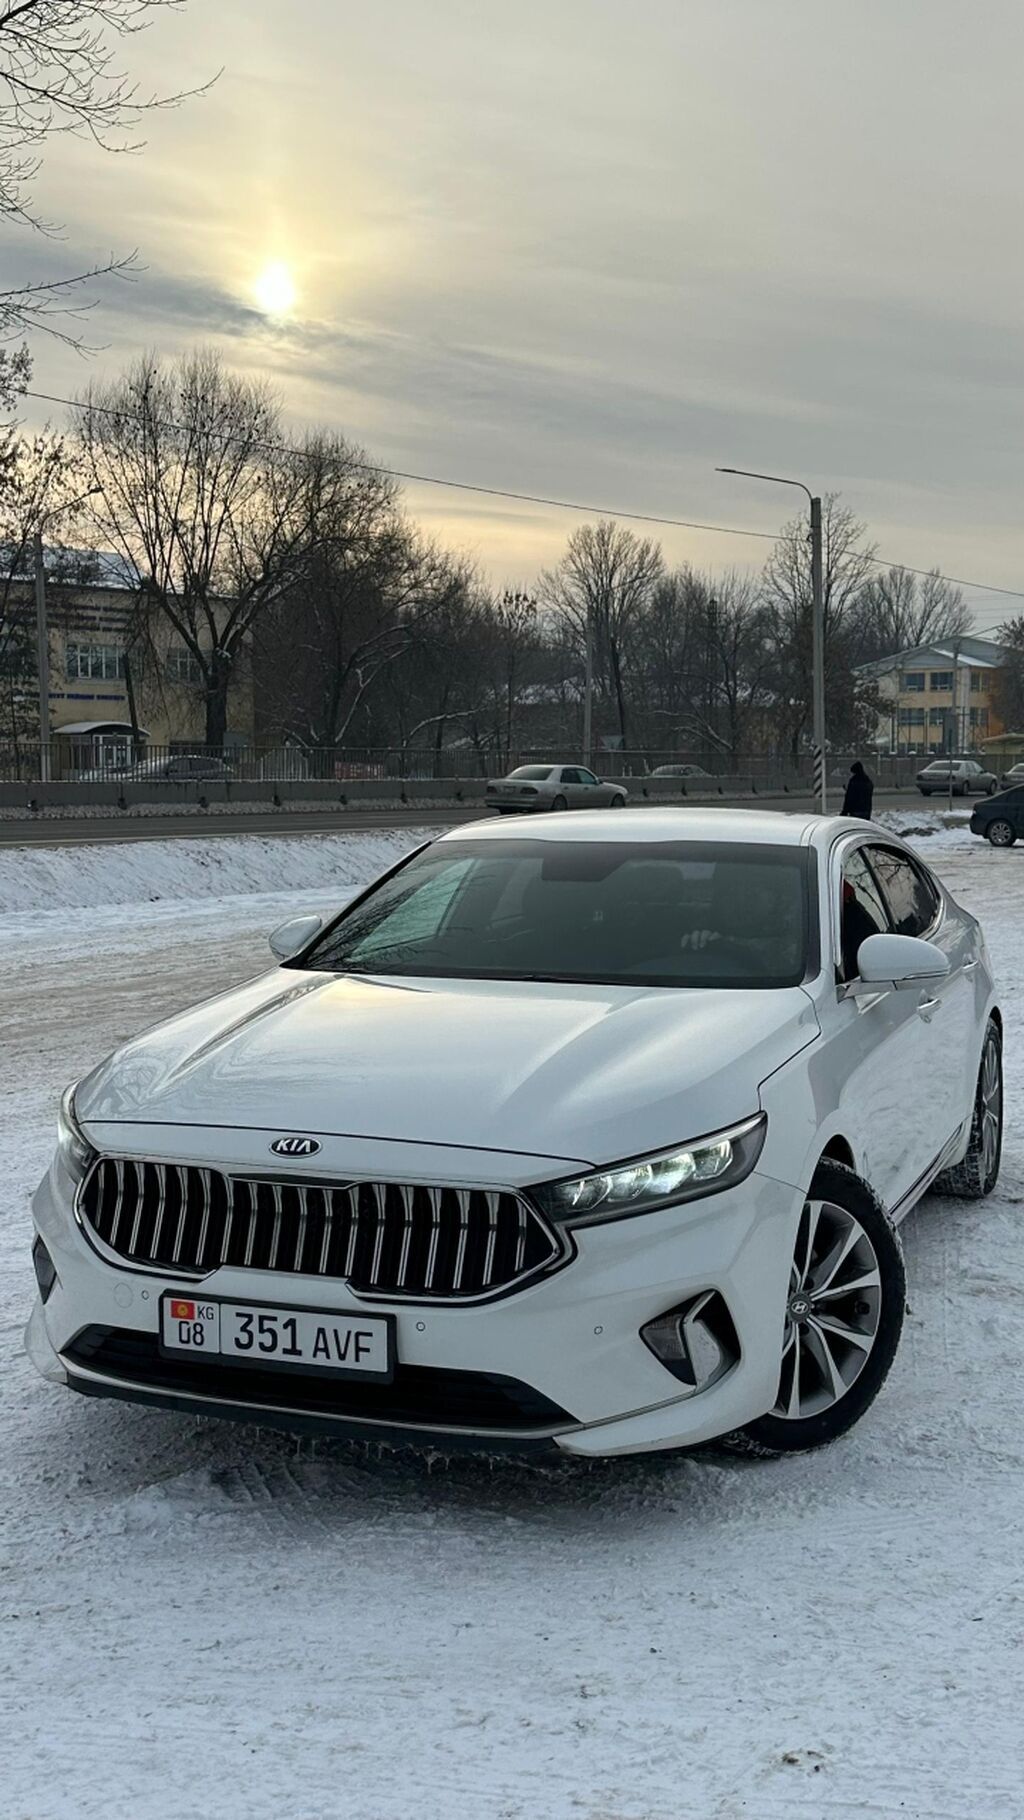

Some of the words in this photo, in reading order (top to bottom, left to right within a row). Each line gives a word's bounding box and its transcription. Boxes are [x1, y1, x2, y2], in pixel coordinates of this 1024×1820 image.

[276, 1139, 311, 1153] KIA
[197, 1306, 215, 1321] KG
[179, 1321, 205, 1346] 08
[234, 1312, 302, 1356] 351
[312, 1327, 374, 1363] AVF
